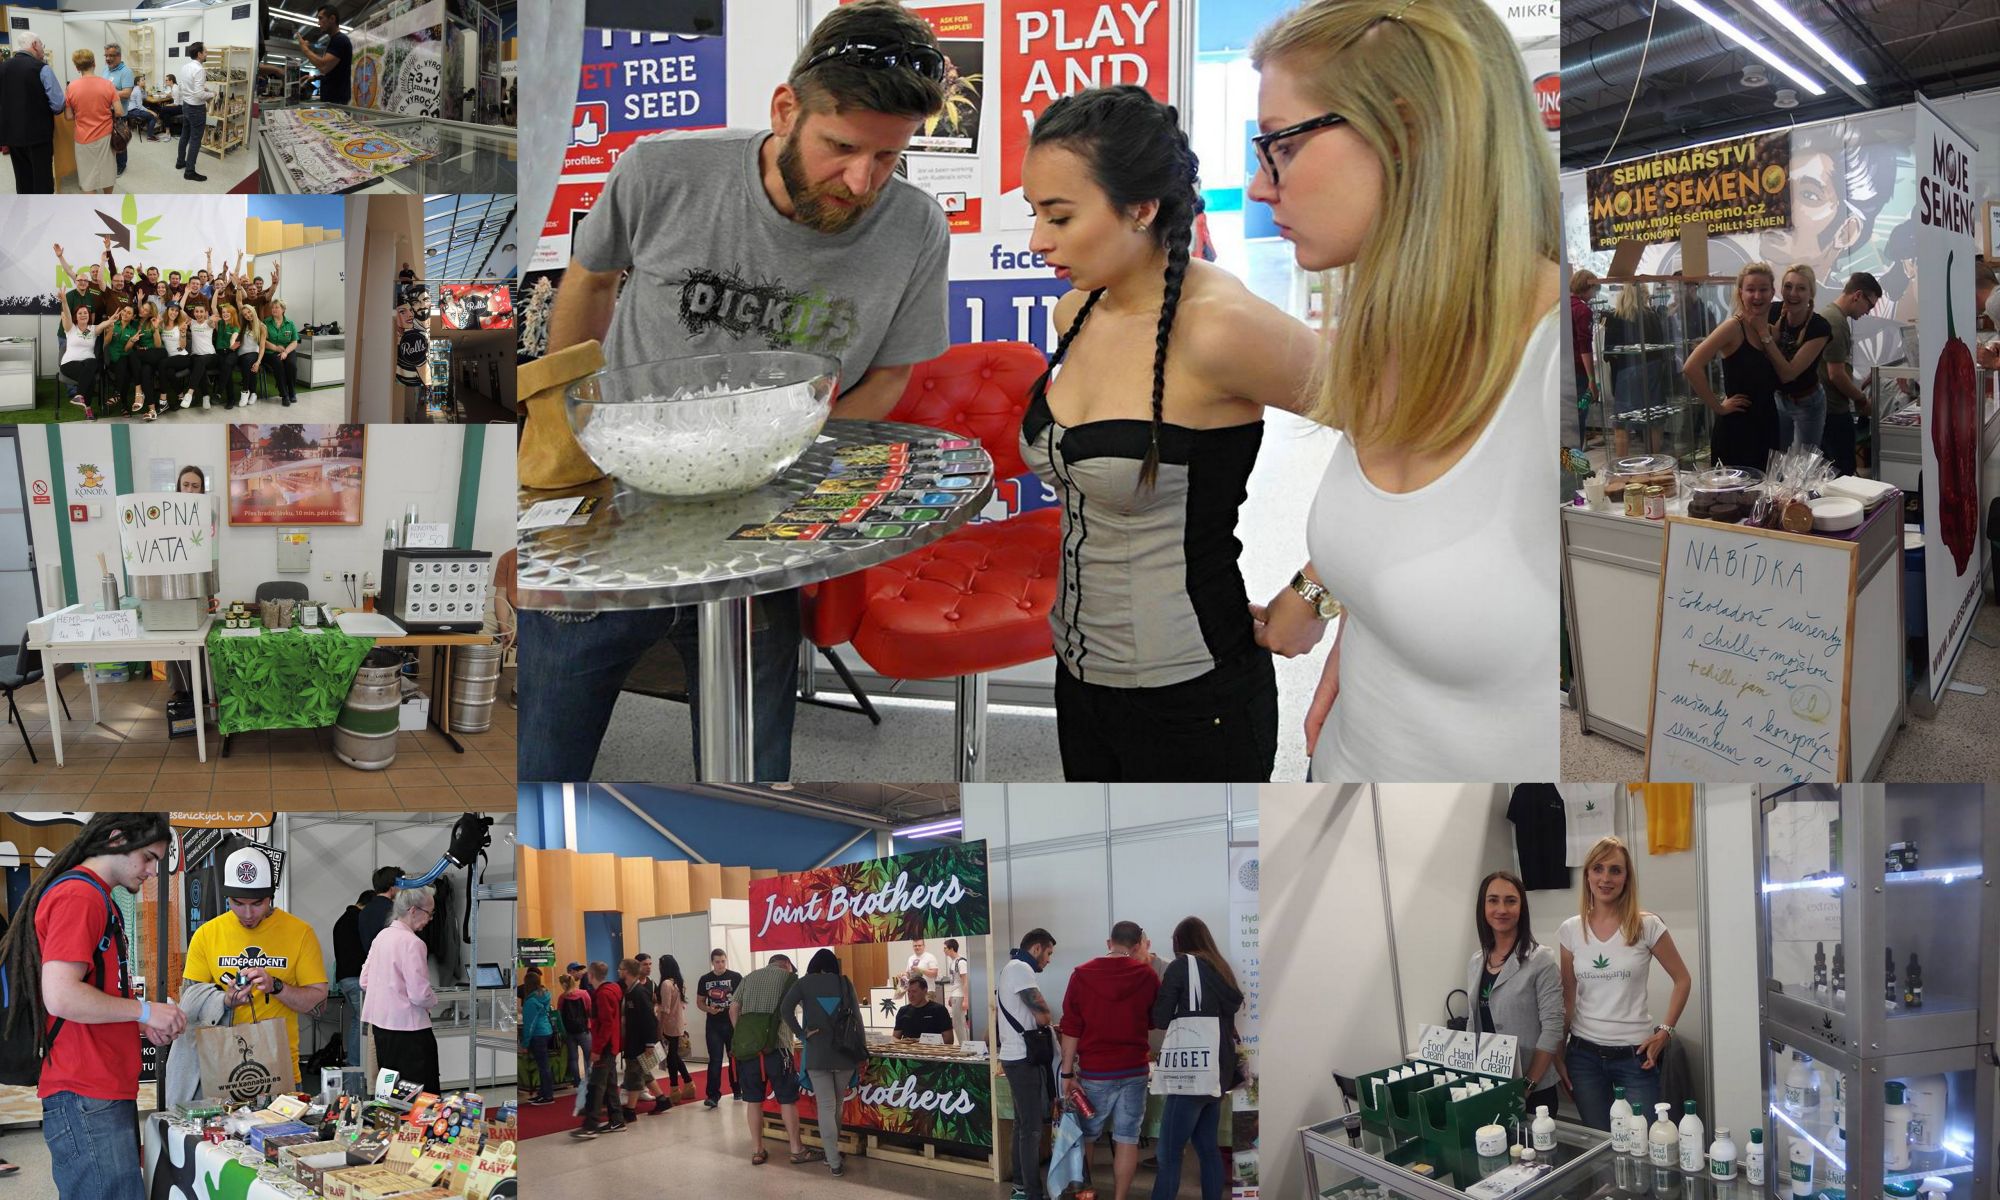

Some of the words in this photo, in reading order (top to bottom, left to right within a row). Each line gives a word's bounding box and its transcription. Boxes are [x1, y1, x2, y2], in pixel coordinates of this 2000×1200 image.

[940, 24, 972, 32] SAMPLES!
[1016, 3, 1158, 54] PLAY
[624, 55, 698, 86] FREE
[1021, 53, 1149, 103] AND
[415, 72, 438, 87] 3+1
[413, 84, 436, 94] ZDARMA
[624, 90, 700, 120] SEED
[564, 155, 604, 168] profiles:
[1614, 138, 1756, 186] SEMENÁŘSTVÍ
[1933, 131, 1968, 194] MOJE
[1594, 186, 1657, 220] MOJE
[1664, 164, 1786, 210] SEMENO
[1613, 203, 1766, 233] www.mojesemeno.cz
[1708, 222, 1743, 234] CHILLI
[1746, 216, 1785, 229] SEMEN
[467, 300, 486, 310] Rolls
[402, 341, 426, 356] Rolls
[74, 488, 108, 498] KONOPA
[136, 536, 188, 563] VATA
[1686, 540, 1804, 594] NABÍDKA
[1704, 625, 1758, 658] chilli
[1778, 610, 1842, 658] sušenky
[1736, 675, 1771, 698] jam
[1671, 694, 1731, 736] sušenky
[1666, 720, 1746, 761] semínkem
[1753, 756, 1772, 768] a
[228, 812, 245, 822] hor
[758, 894, 822, 938] Joint
[827, 871, 965, 922] Brothers
[1242, 928, 1248, 936] u
[1242, 940, 1250, 948] to
[221, 957, 284, 967] INDEPENDENT
[1428, 1040, 1444, 1052] Foot
[1422, 1046, 1444, 1062] Cream
[1454, 1048, 1474, 1061] Hand
[1490, 1050, 1512, 1065] Hair
[1448, 1055, 1474, 1070] Cream
[1480, 1058, 1511, 1076] Cream
[218, 1076, 282, 1090] www.kannabia.es
[398, 1131, 420, 1142] RAW
[489, 1128, 516, 1140] RAW
[426, 1150, 450, 1160] RAW
[479, 1160, 510, 1175] RAW
[1715, 1166, 1727, 1174] Oil
